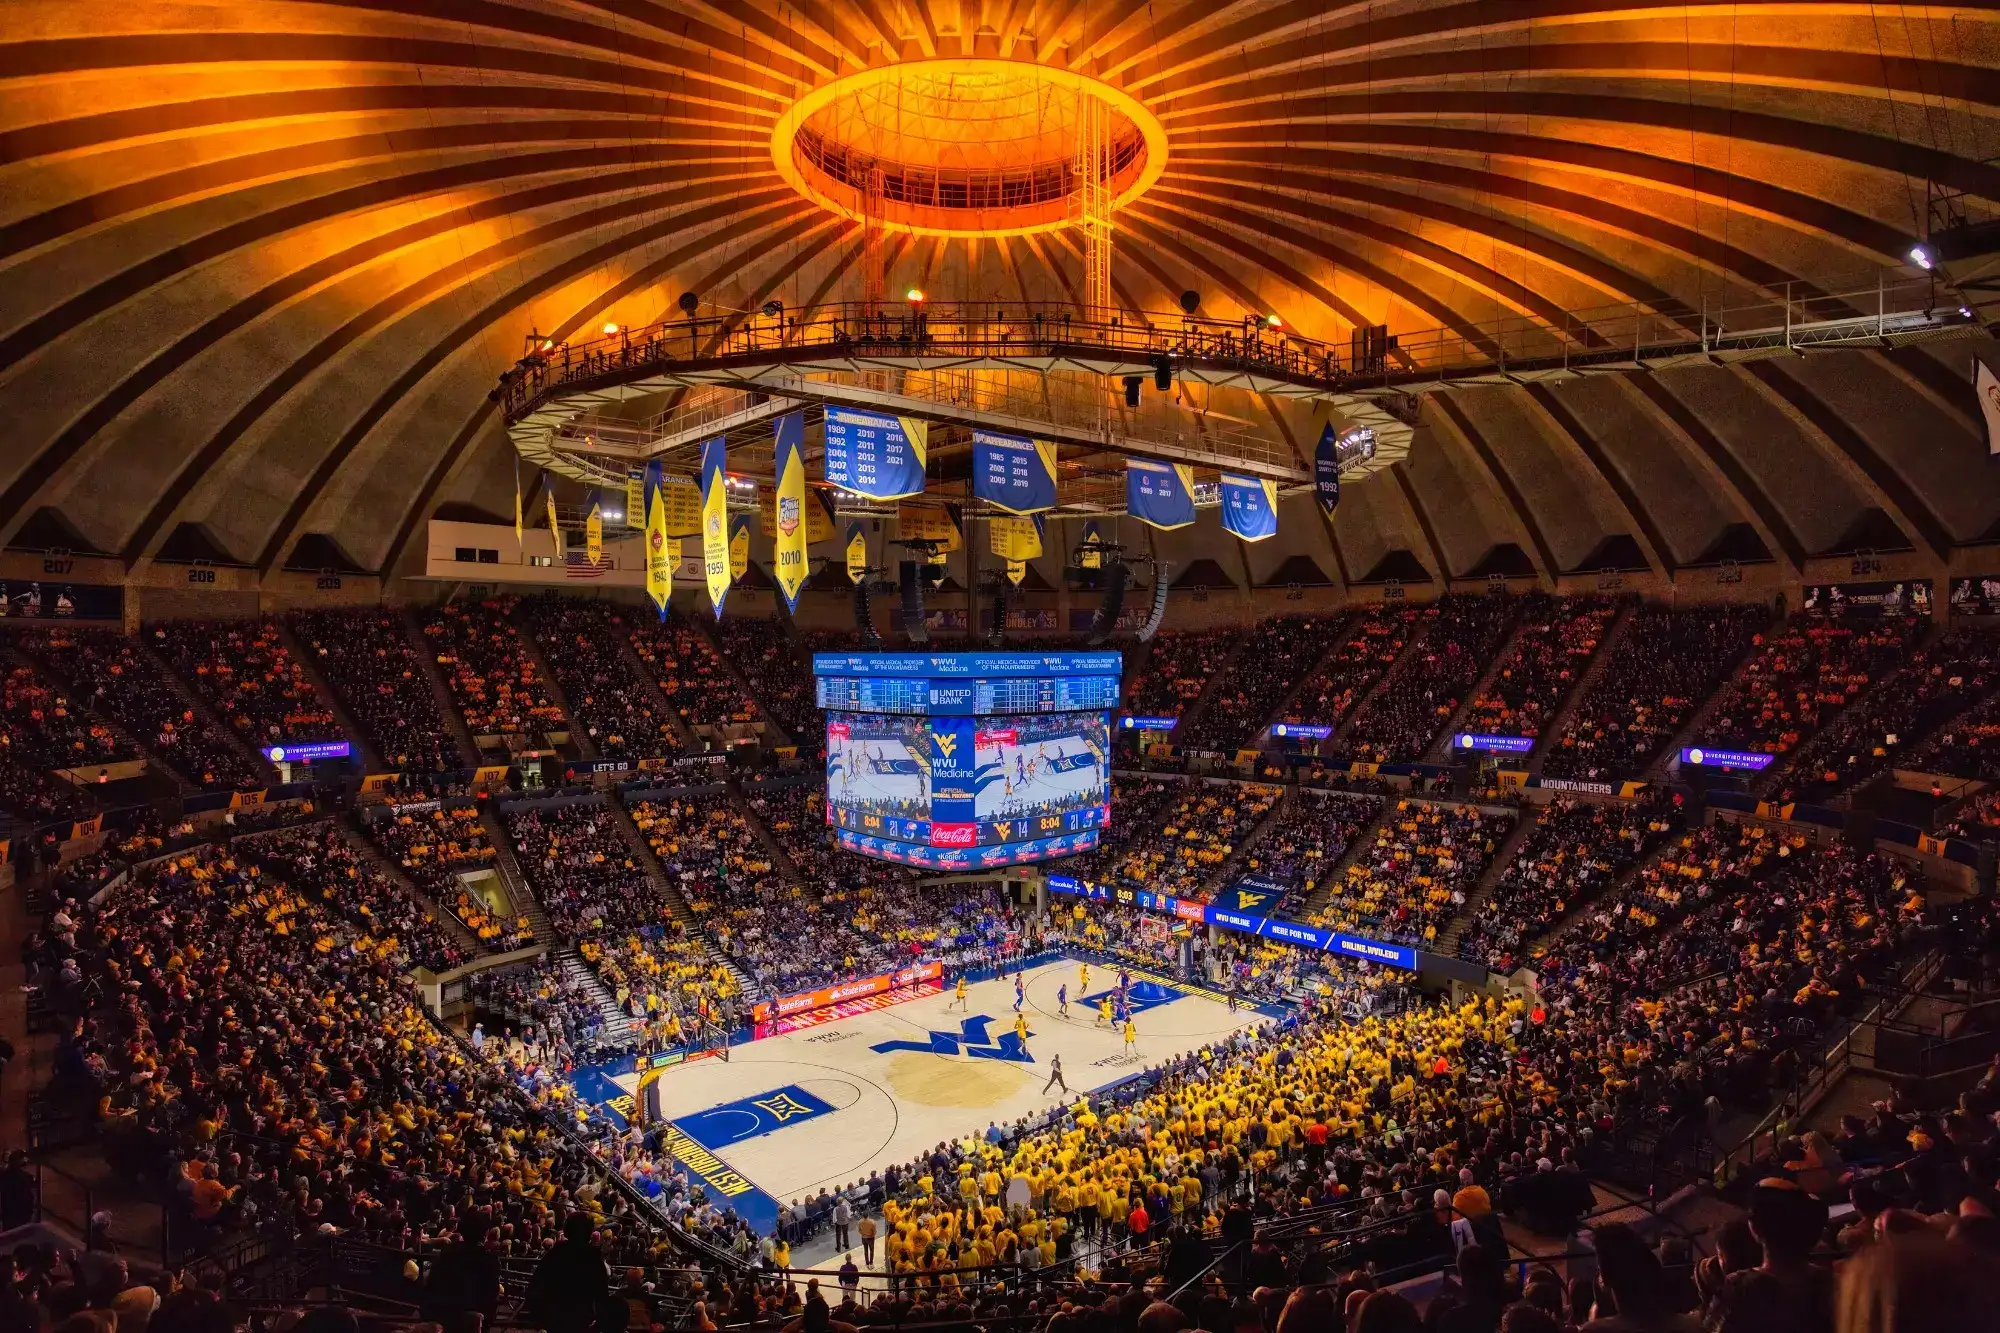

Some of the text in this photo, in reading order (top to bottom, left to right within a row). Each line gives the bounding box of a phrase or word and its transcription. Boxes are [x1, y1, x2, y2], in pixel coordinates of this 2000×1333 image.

[843, 414, 899, 429] APPEARANCES
[828, 425, 904, 442] 1989 2010 2016
[828, 437, 904, 454] 1992 2011 2017
[985, 437, 1034, 450] APPEARANCES
[828, 448, 904, 465] 2004 2012 2021
[989, 452, 1028, 465] 1985 2015
[828, 460, 876, 473] 2007 2013
[989, 464, 1028, 476] 2005 2018
[828, 472, 876, 484] 2008 2014
[990, 476, 1028, 488] 2009 2019
[1320, 481, 1338, 492] 1992
[1158, 489, 1172, 498] 2017
[781, 550, 800, 566] 2010
[44, 558, 74, 574] 207
[706, 562, 724, 575] 1959
[188, 570, 216, 582] 208
[1006, 618, 1036, 628] UNDLEY
[1116, 616, 1126, 628] ST
[932, 758, 956, 768] WVU
[1244, 754, 1253, 762] 114
[593, 763, 614, 772] LET'S
[934, 768, 974, 778] Medicine
[1358, 764, 1370, 773] 115
[484, 770, 500, 781] 107
[1504, 776, 1517, 786] 116
[1541, 779, 1612, 794] MOUNTAINEERS
[241, 794, 258, 805] 105
[1768, 804, 1781, 817] 118
[80, 821, 94, 836] 104
[850, 812, 898, 836] 14 8:04 21
[1018, 814, 1078, 838] 14 8:04 21
[932, 826, 974, 842] Coca-Cola
[1927, 838, 1937, 854] 119
[940, 852, 968, 862] Kegler's
[1117, 889, 1132, 900] 8:03
[1143, 896, 1150, 907] 21
[1180, 904, 1202, 917] Coca-Cola
[1216, 912, 1250, 927] WVU ONLINE
[1272, 926, 1317, 942] HERE FOR YOU.
[1342, 940, 1399, 961] ONLINE.WVU.EDU
[842, 982, 876, 996] State Farm
[780, 998, 813, 1012] tate Farm
[672, 1138, 754, 1197] WEST VIRGINIA
